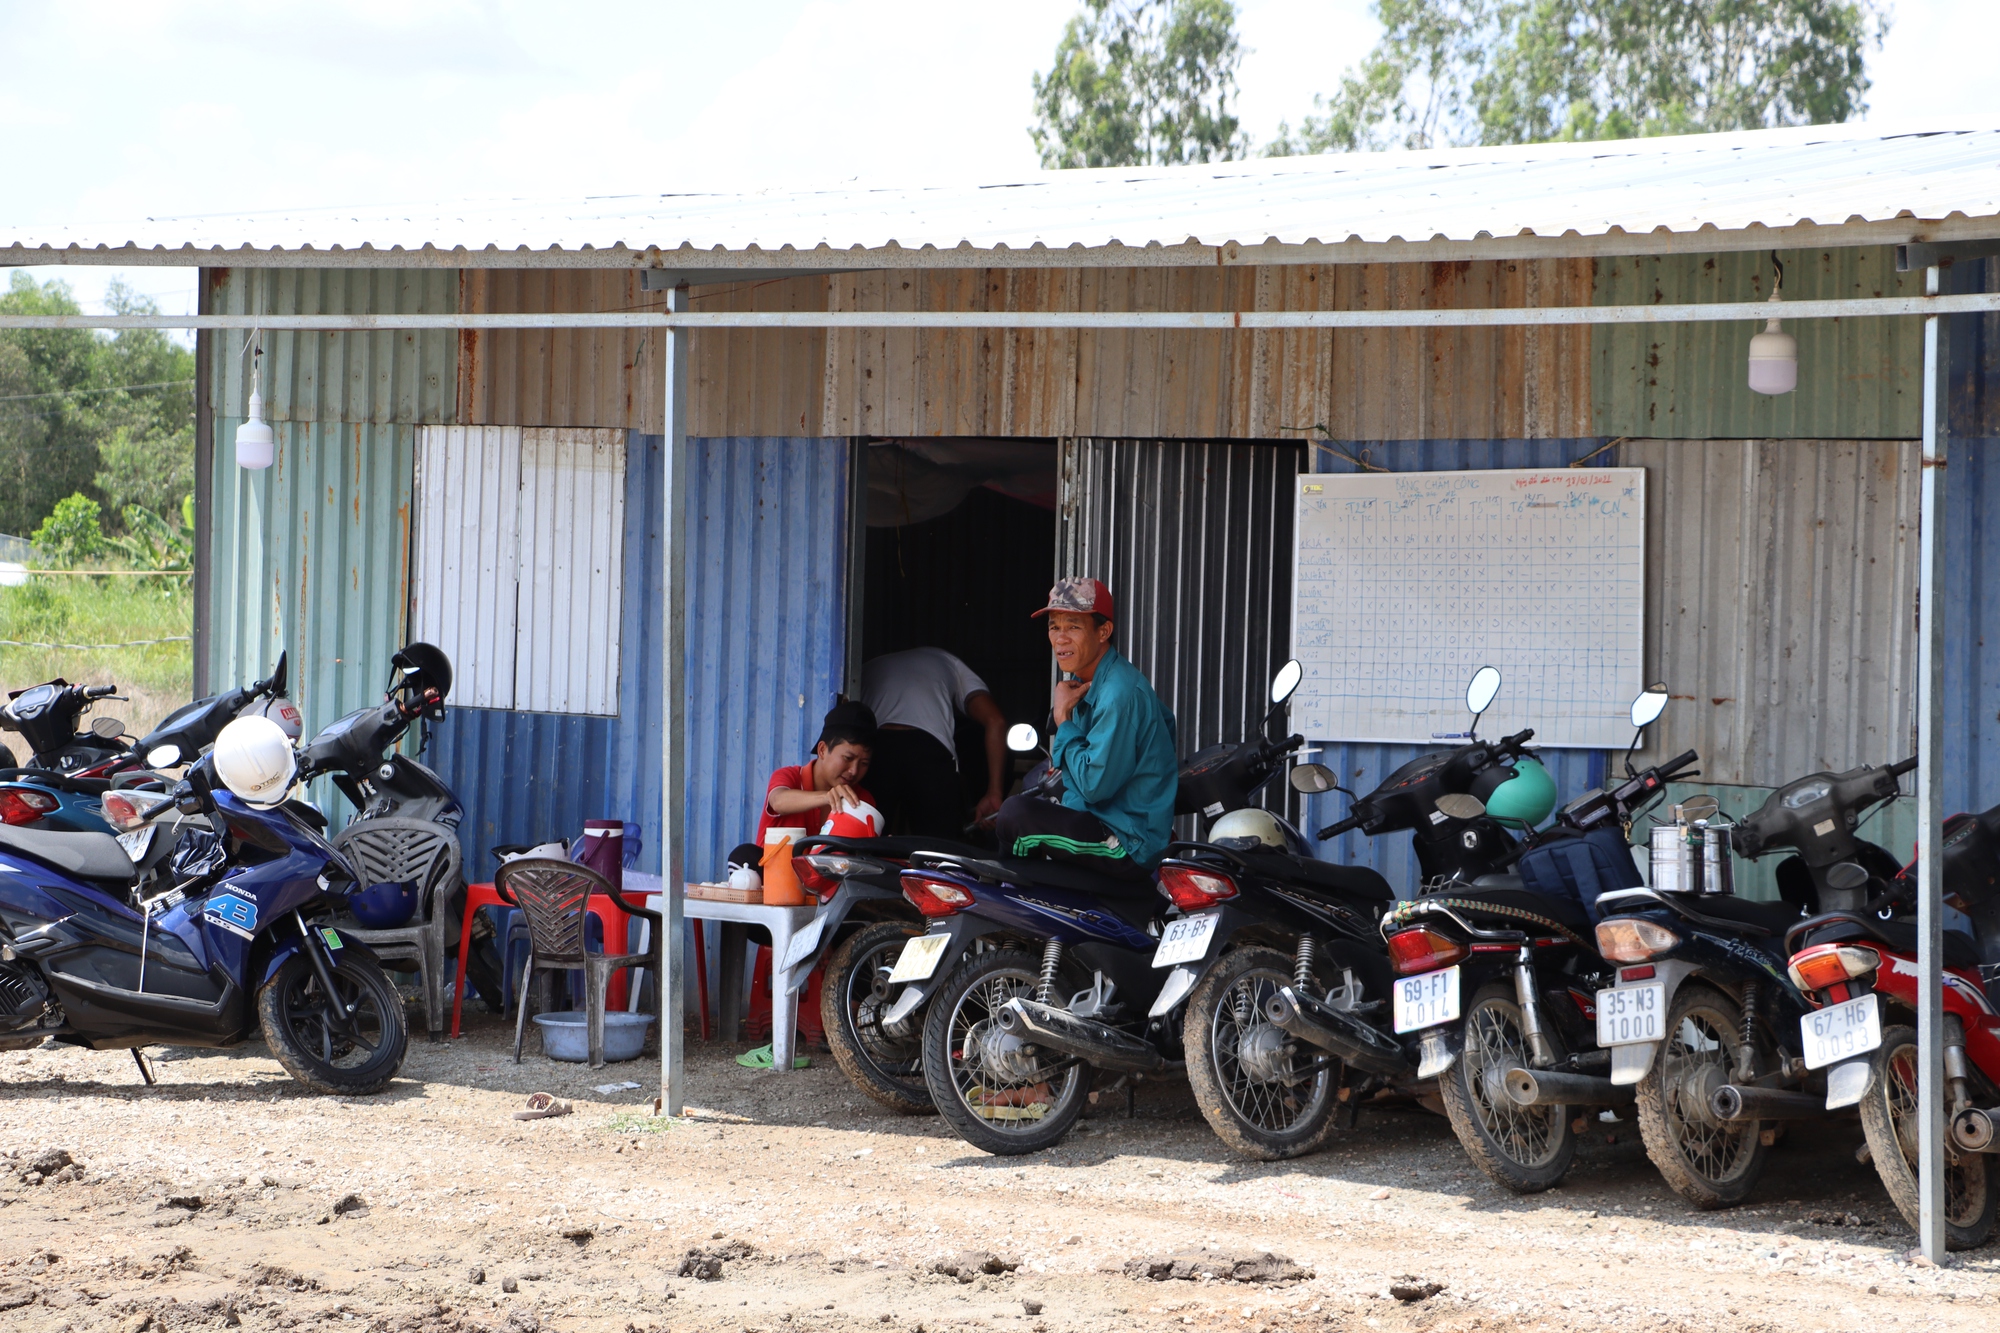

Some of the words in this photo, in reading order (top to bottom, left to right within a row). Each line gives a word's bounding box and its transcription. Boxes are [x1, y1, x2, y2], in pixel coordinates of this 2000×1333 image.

[1454, 476, 1480, 490] CÔNG
[1346, 501, 1367, 514] T2
[1383, 500, 1402, 515] T3
[1469, 500, 1484, 514] T5
[1509, 501, 1525, 513] T6
[1601, 498, 1621, 515] CN
[224, 882, 257, 901] HONDA
[1169, 918, 1210, 942] 63-B5
[1404, 973, 1448, 1003] 69-F1
[1405, 996, 1450, 1028] 4014
[1607, 987, 1654, 1016] 35-N3
[1609, 1014, 1655, 1041] 1000
[1814, 1001, 1867, 1037] 67-H6
[1816, 1026, 1869, 1060] 0093
